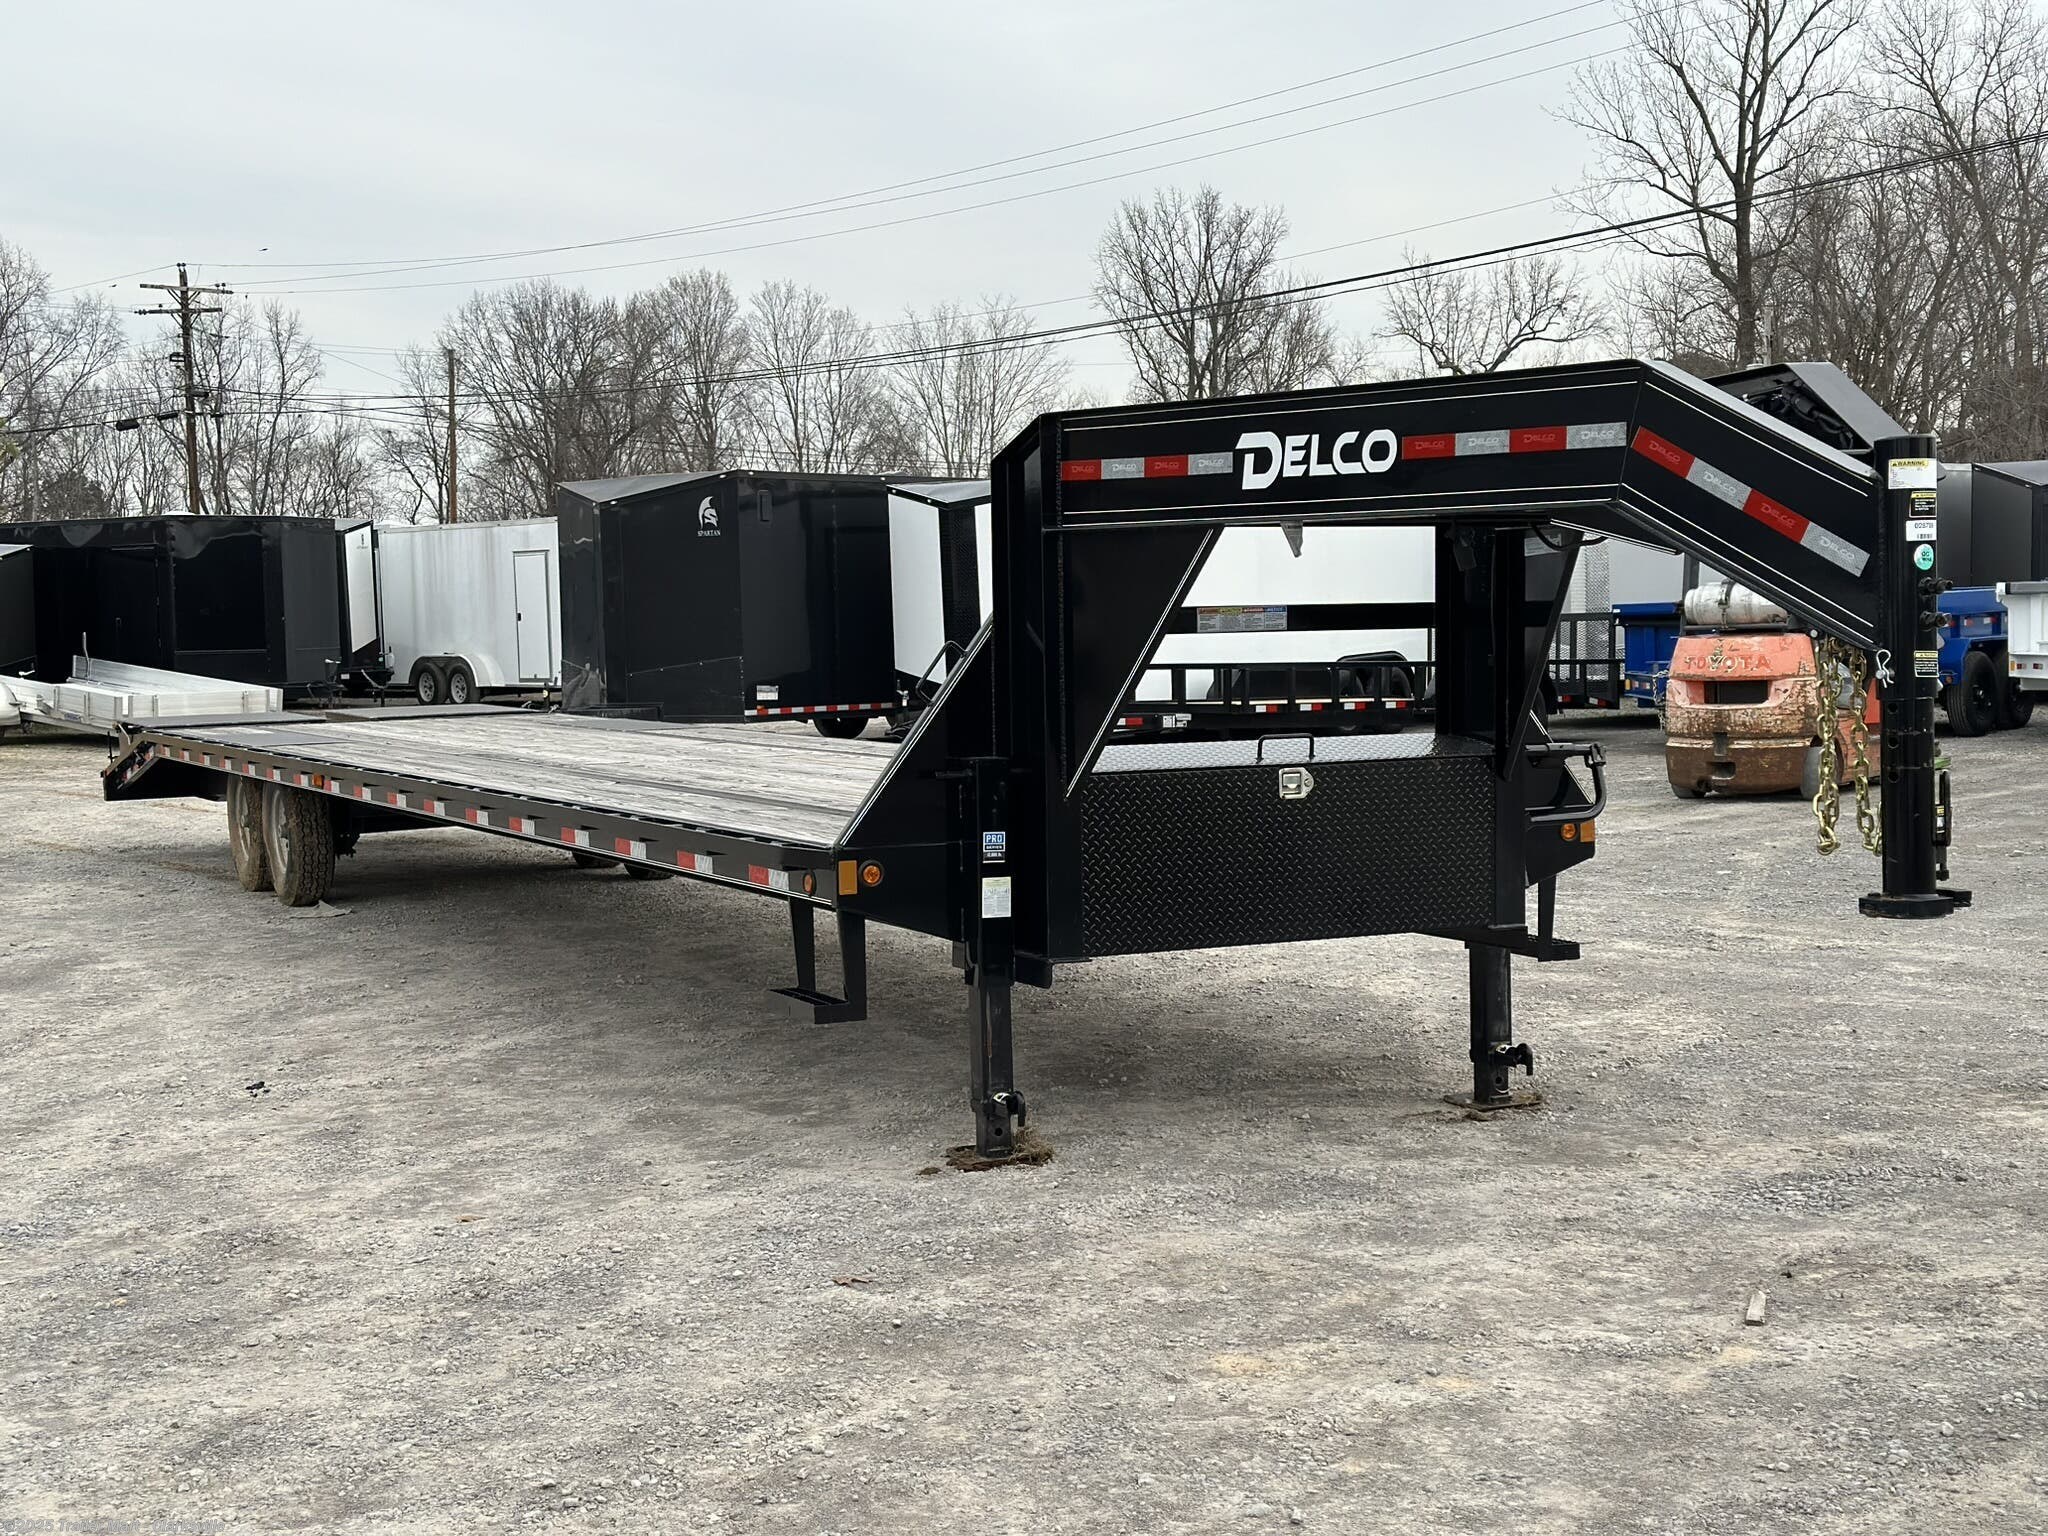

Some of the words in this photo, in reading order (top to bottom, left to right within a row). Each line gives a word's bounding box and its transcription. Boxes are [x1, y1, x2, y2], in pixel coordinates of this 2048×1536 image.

[1415, 440, 1445, 450] DELCO
[1468, 436, 1500, 447] DELCO
[1523, 433, 1555, 443] DELCO
[1580, 430, 1615, 440] DELCO
[1112, 463, 1137, 472] DELCO
[1198, 458, 1225, 468] DELCO
[1235, 429, 1398, 490] DELCO
[1649, 440, 1681, 463] DELCO
[1703, 471, 1737, 496] DELCO
[1760, 502, 1796, 527] DELCO
[1820, 535, 1855, 560] DELCO
[1684, 655, 1774, 672] TOYOTA
[986, 834, 1003, 843] PRO
